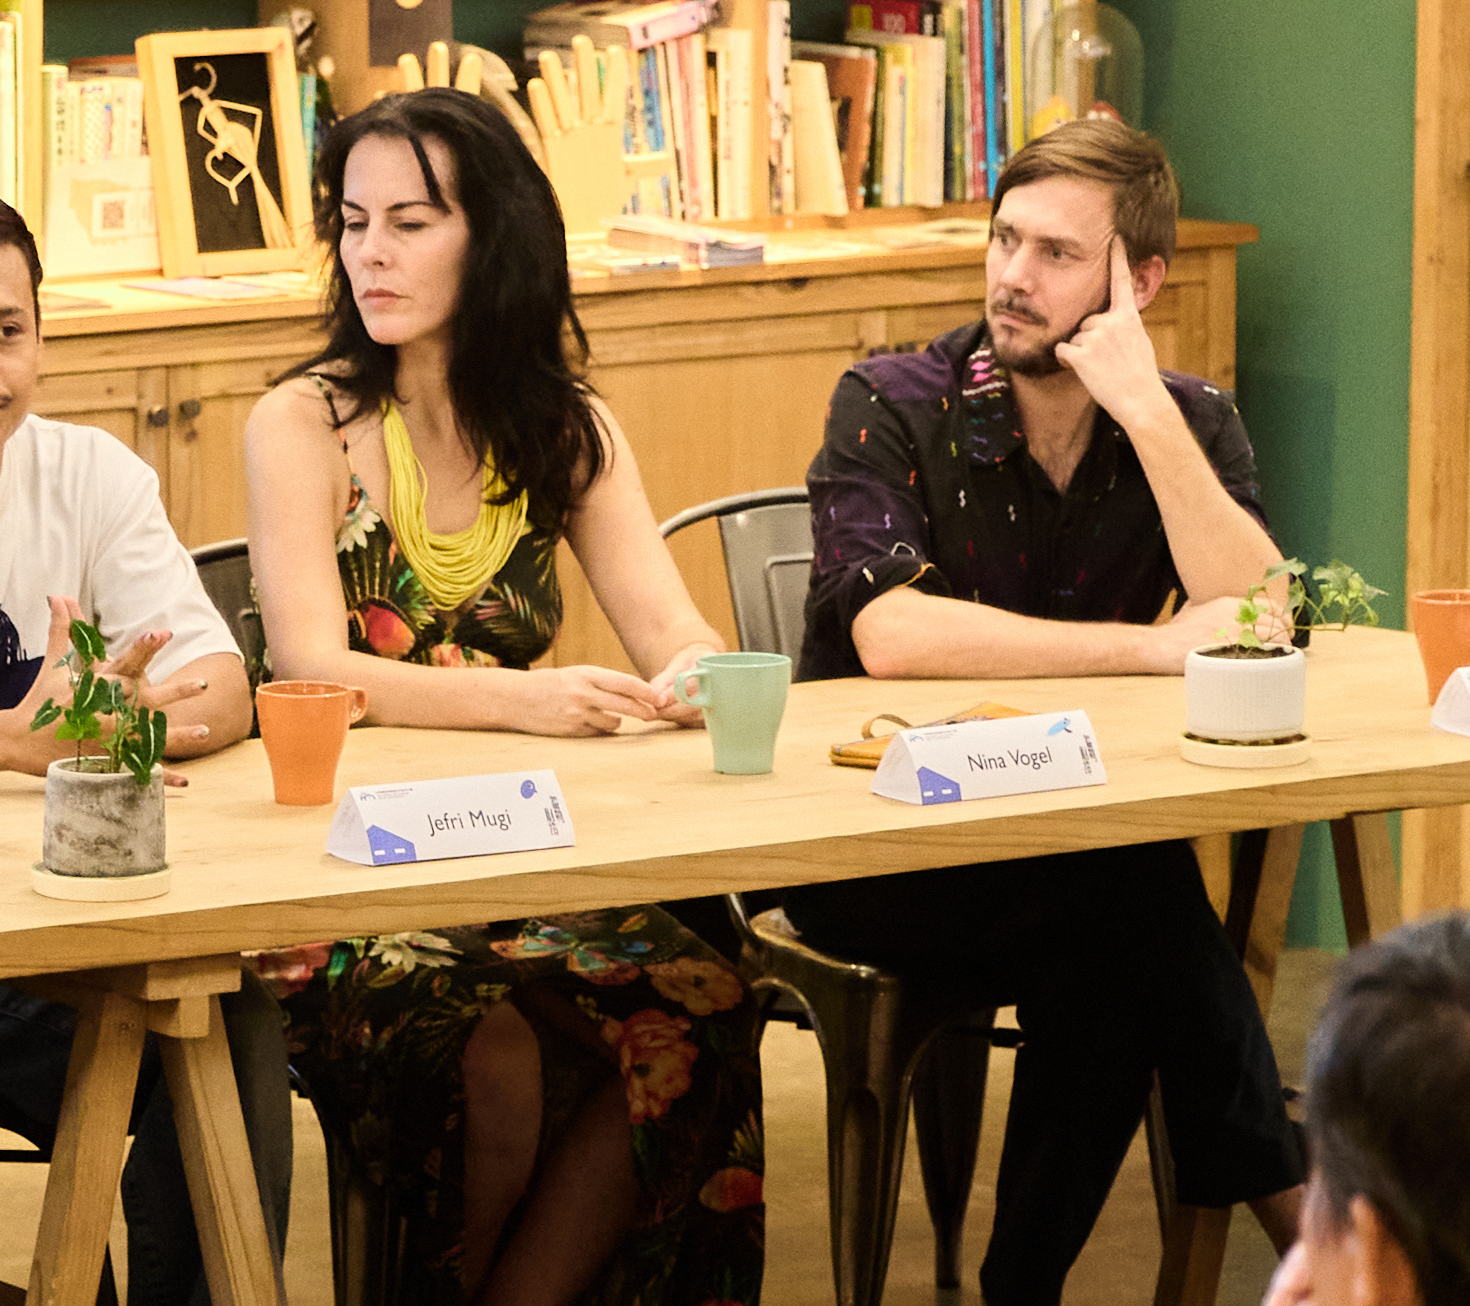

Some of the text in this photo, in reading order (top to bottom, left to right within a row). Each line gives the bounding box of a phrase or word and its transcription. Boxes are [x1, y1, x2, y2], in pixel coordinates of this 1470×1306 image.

[967, 752, 1007, 772] Nina
[1007, 746, 1053, 772] Vogel
[427, 809, 512, 837] Jefri Mugi
